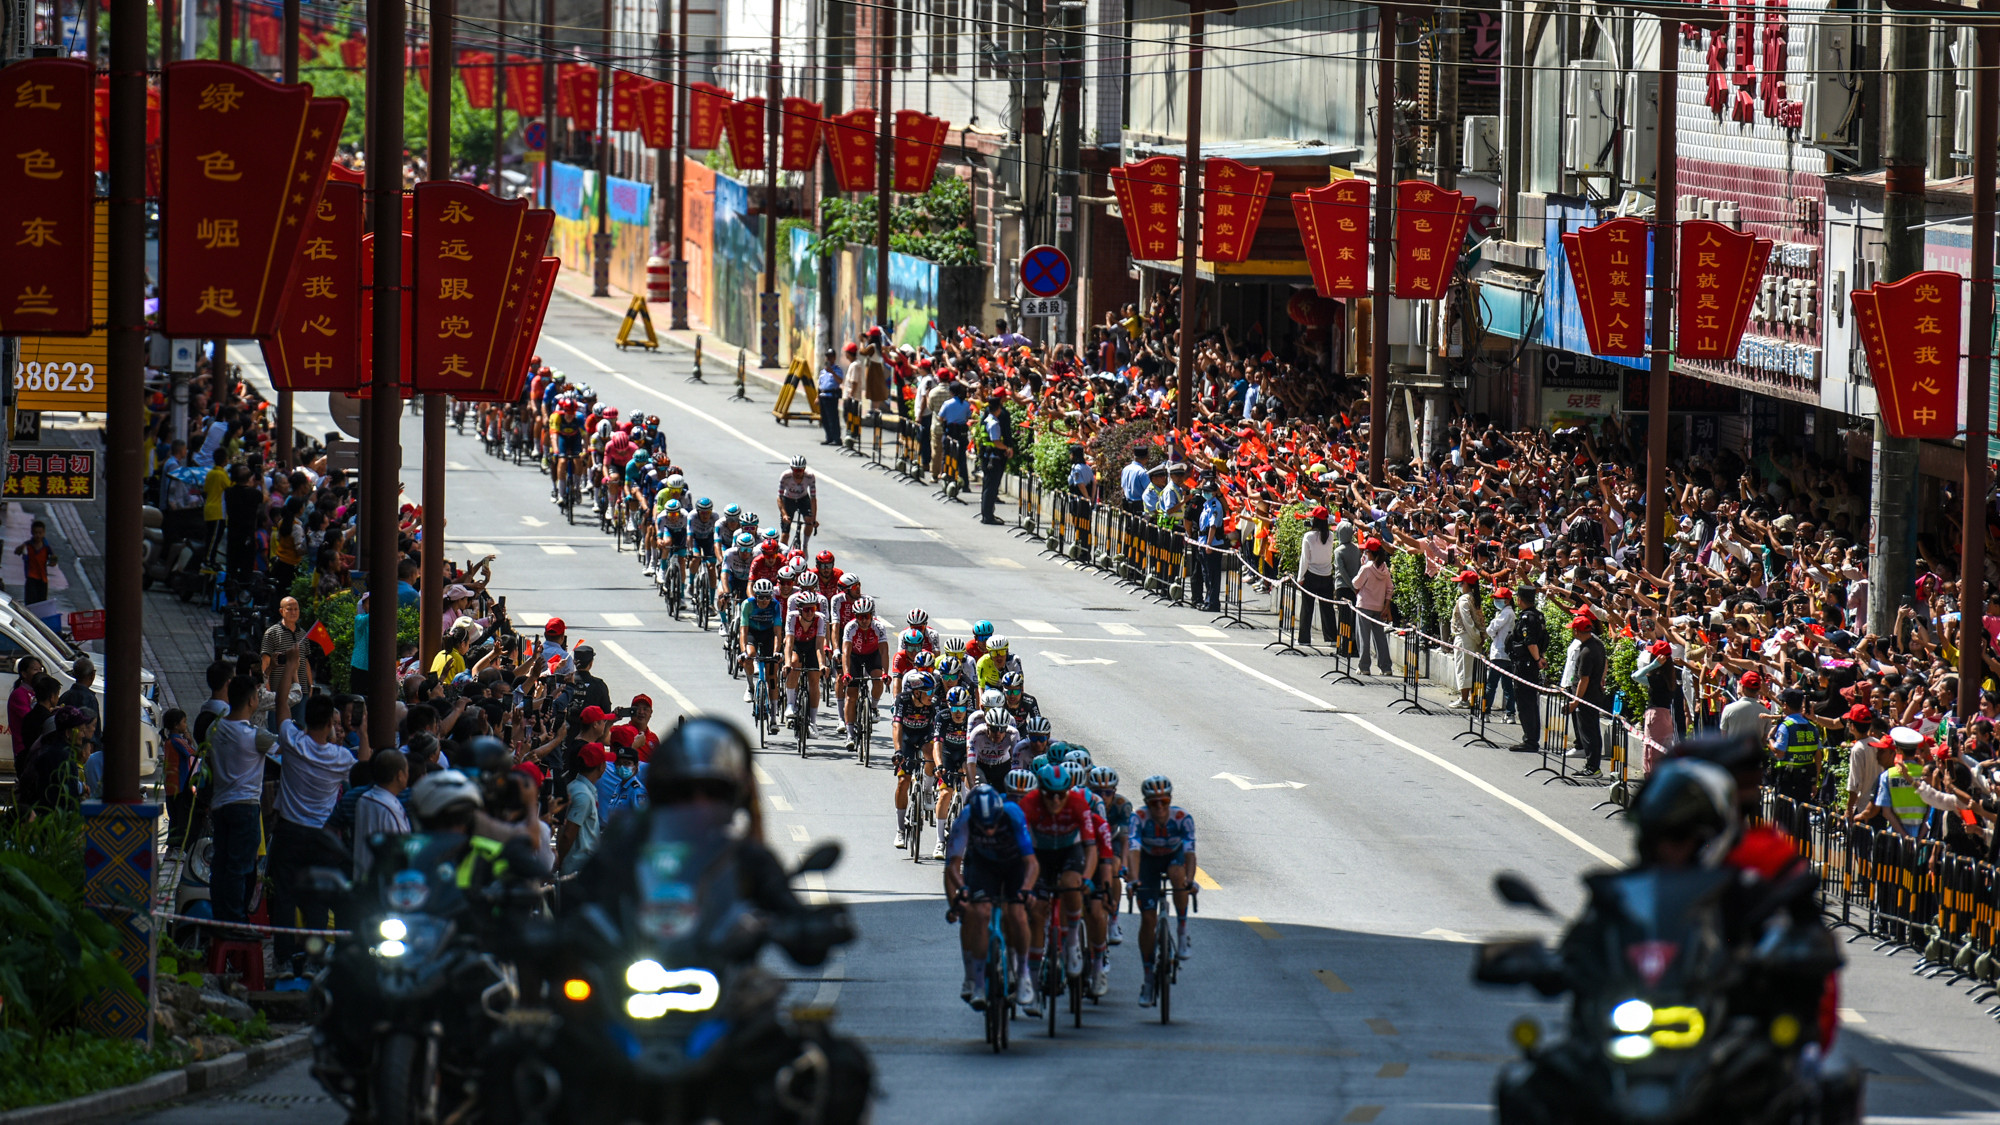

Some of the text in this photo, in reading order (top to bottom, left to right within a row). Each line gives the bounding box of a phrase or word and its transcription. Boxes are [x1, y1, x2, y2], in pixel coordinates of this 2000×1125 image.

[14, 80, 62, 315] 红色东兰
[196, 83, 244, 318] 绿色崛起
[1148, 163, 1168, 253] 党在我心中
[1216, 165, 1236, 255] 永远跟党走
[1335, 188, 1357, 290] 红色东兰
[1411, 189, 1434, 291] 绿色崛起
[438, 200, 474, 378] 永远跟党走
[1026, 301, 1063, 315] 全路段
[1607, 228, 1631, 349] 江山就是人民
[1696, 231, 1721, 351] 人民就是江山
[1911, 283, 1942, 426] 党在我心中
